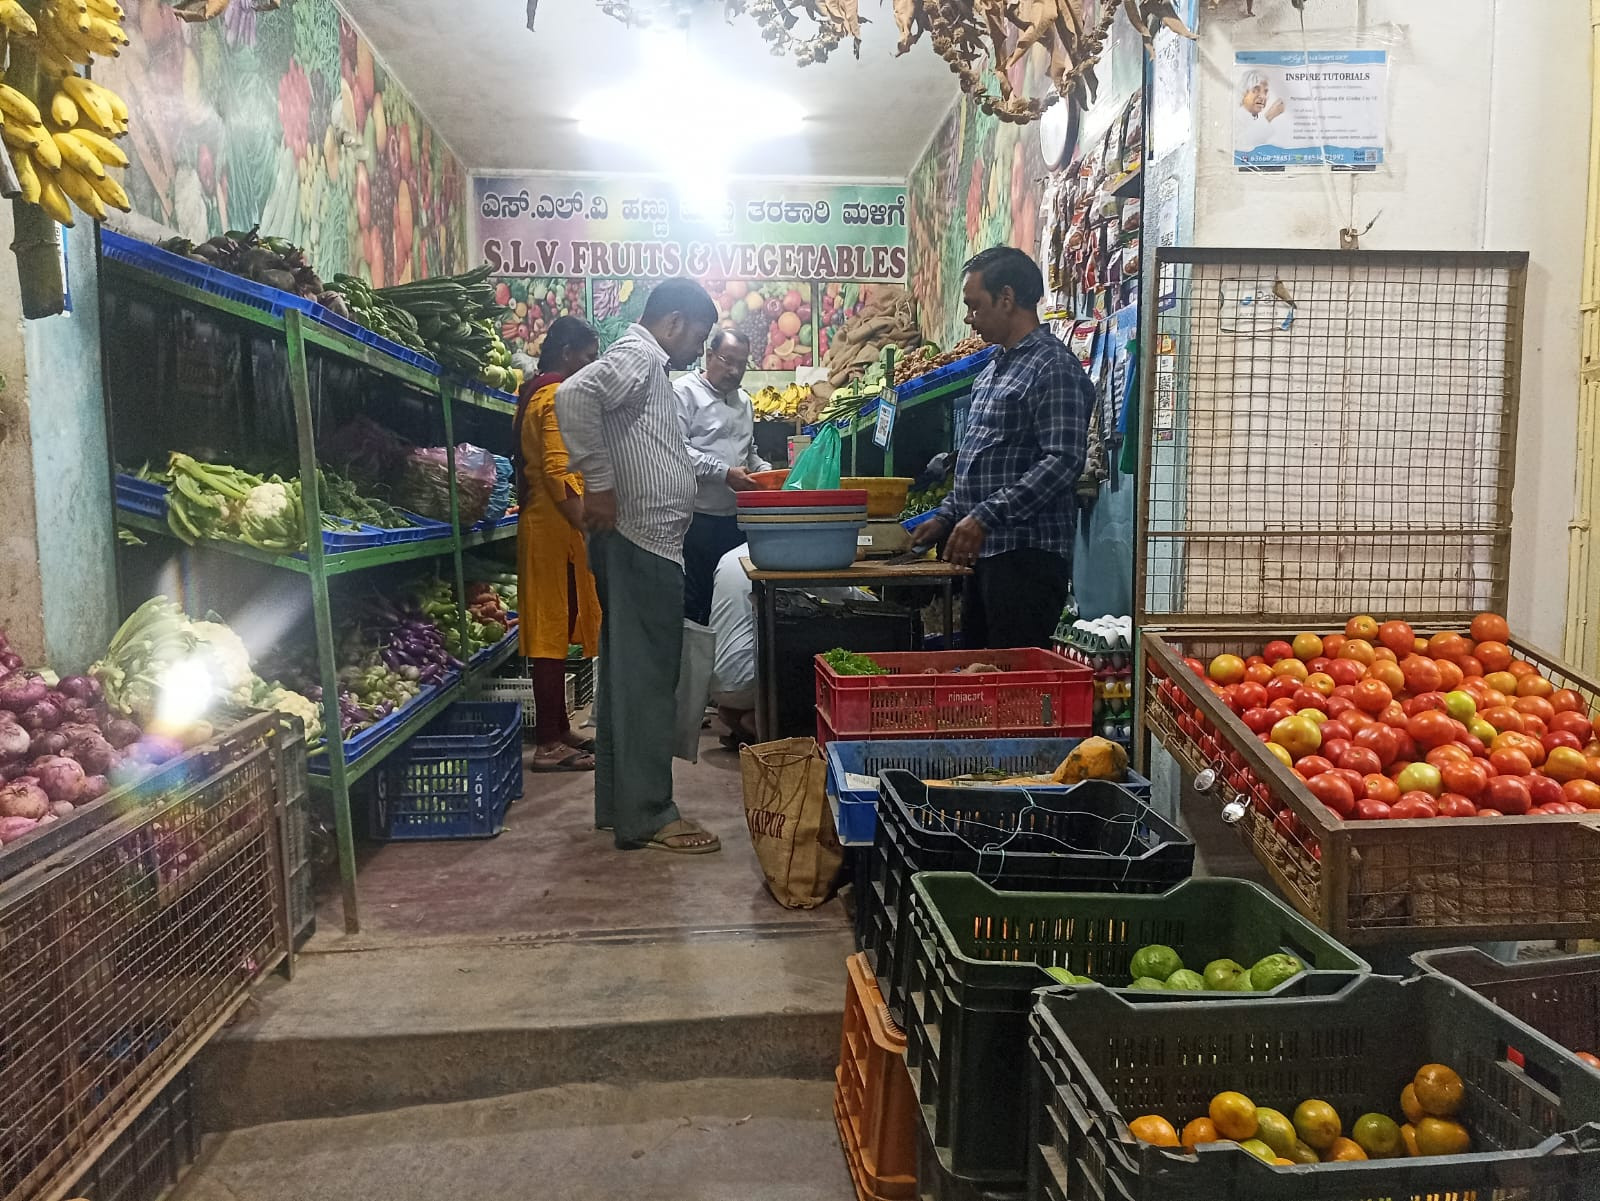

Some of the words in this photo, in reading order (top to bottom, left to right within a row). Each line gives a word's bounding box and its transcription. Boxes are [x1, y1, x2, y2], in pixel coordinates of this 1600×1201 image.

[1322, 72, 1370, 81] TUTORIALS
[482, 189, 608, 219] ಎಸ್.ಎಲ್.ವಿ
[622, 198, 668, 236] ಹಣ್ಣು
[748, 199, 831, 224] ತರಕಾರಿ
[842, 194, 906, 226] ಮಳಿಗೆ
[484, 239, 564, 274] S.L.V.
[571, 241, 680, 275] FRUITS
[687, 242, 711, 277] &
[716, 243, 907, 279] VEGETABLES
[948, 691, 984, 703] ninjacart
